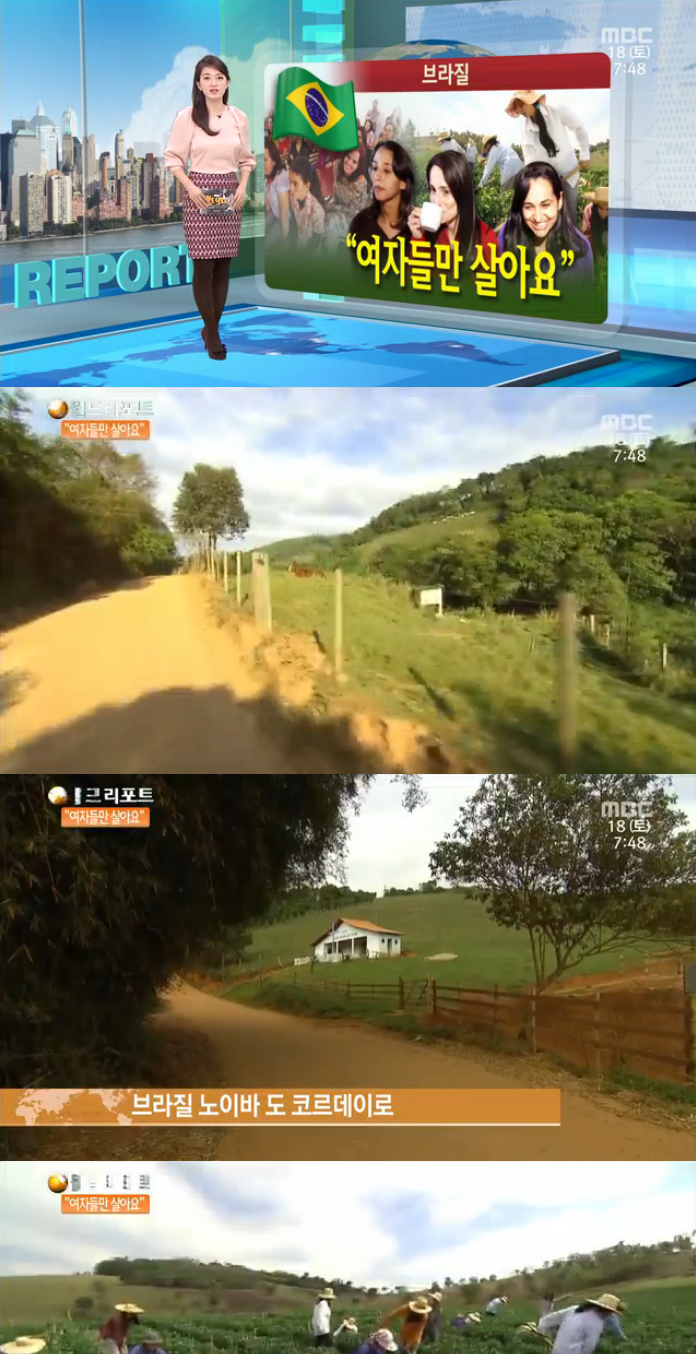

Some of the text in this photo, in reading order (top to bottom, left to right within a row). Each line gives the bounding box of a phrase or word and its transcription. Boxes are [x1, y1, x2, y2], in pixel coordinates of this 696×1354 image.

[422, 63, 469, 86] 브라질
[346, 233, 575, 299] “여자들만 살아요”
